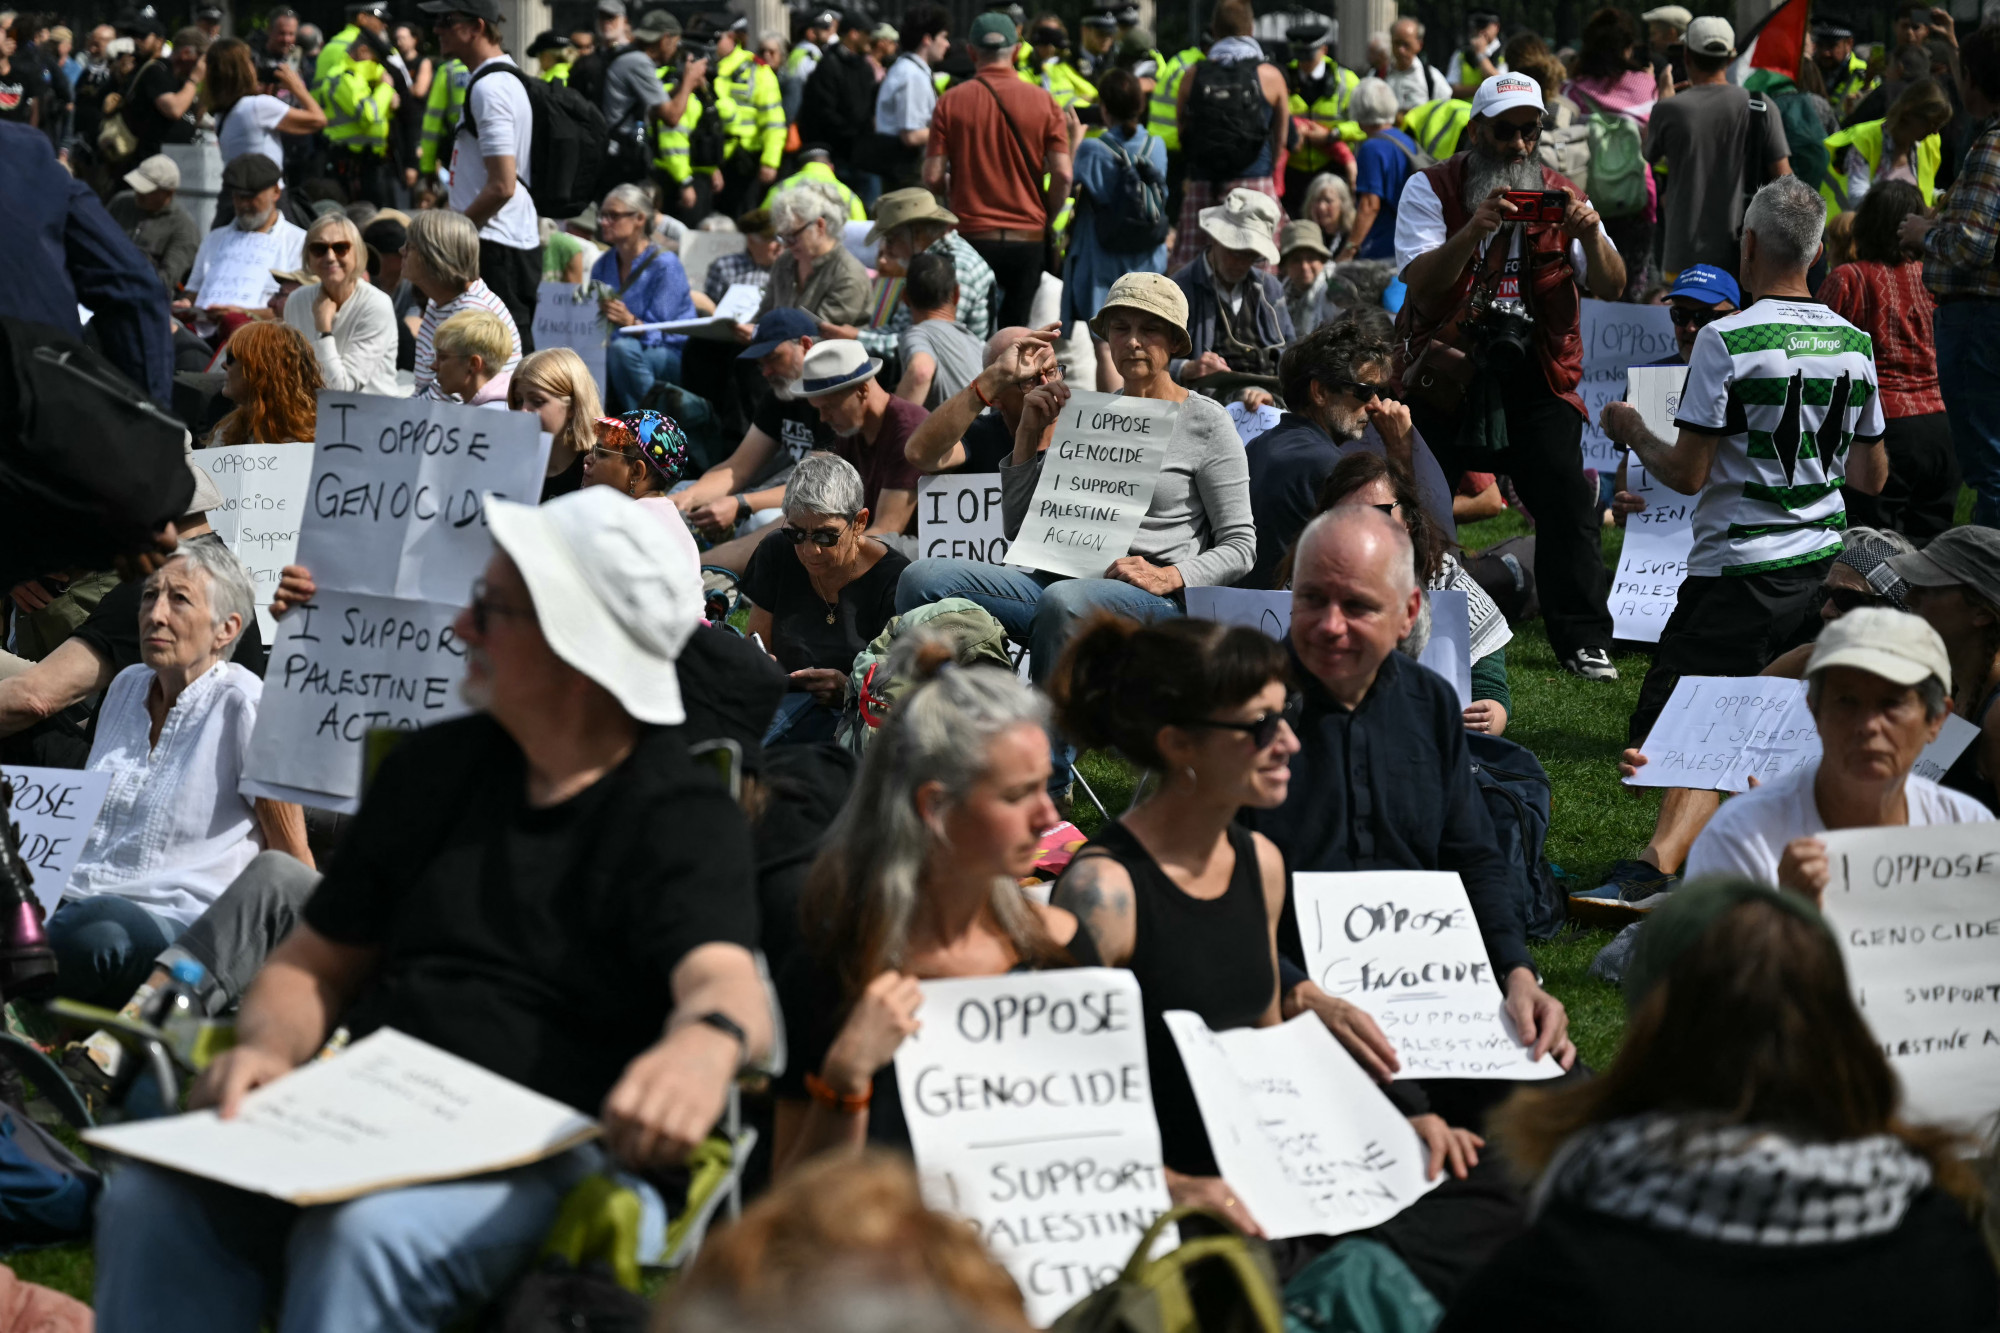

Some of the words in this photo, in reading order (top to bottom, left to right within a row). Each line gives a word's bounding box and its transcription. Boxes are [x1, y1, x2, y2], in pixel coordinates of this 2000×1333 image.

[1787, 336, 1810, 351] San
[1810, 336, 1841, 352] Jorge
[324, 403, 363, 453] I
[378, 418, 490, 462] OPPOSE
[1075, 409, 1083, 429] I
[1091, 412, 1151, 434] OPPOSE
[1059, 440, 1144, 463] GENOCIDE
[1053, 473, 1061, 491] I
[1069, 475, 1141, 497] SUPPORT
[926, 491, 948, 525] I
[957, 487, 1003, 524] OP
[1039, 499, 1121, 522] PALESTINE
[927, 537, 1009, 567] GENO
[1043, 526, 1108, 552] ACTION
[1615, 581, 1679, 598] PALES
[1618, 600, 1675, 617] ACT
[288, 603, 321, 643] I
[341, 607, 469, 660] SUPPOR
[283, 653, 450, 710] PALESTINE
[1660, 750, 1781, 772] PALESTINE
[1872, 851, 2000, 889] OPPOSE
[1343, 900, 1471, 943] OPPOSE
[1850, 917, 2000, 948] GENOCIDE
[1322, 956, 1492, 996] GENOCIDE
[956, 988, 1131, 1044] OPPOSE
[914, 1061, 1142, 1118] GENOCIDE
[989, 1156, 1163, 1203] SUPPORT
